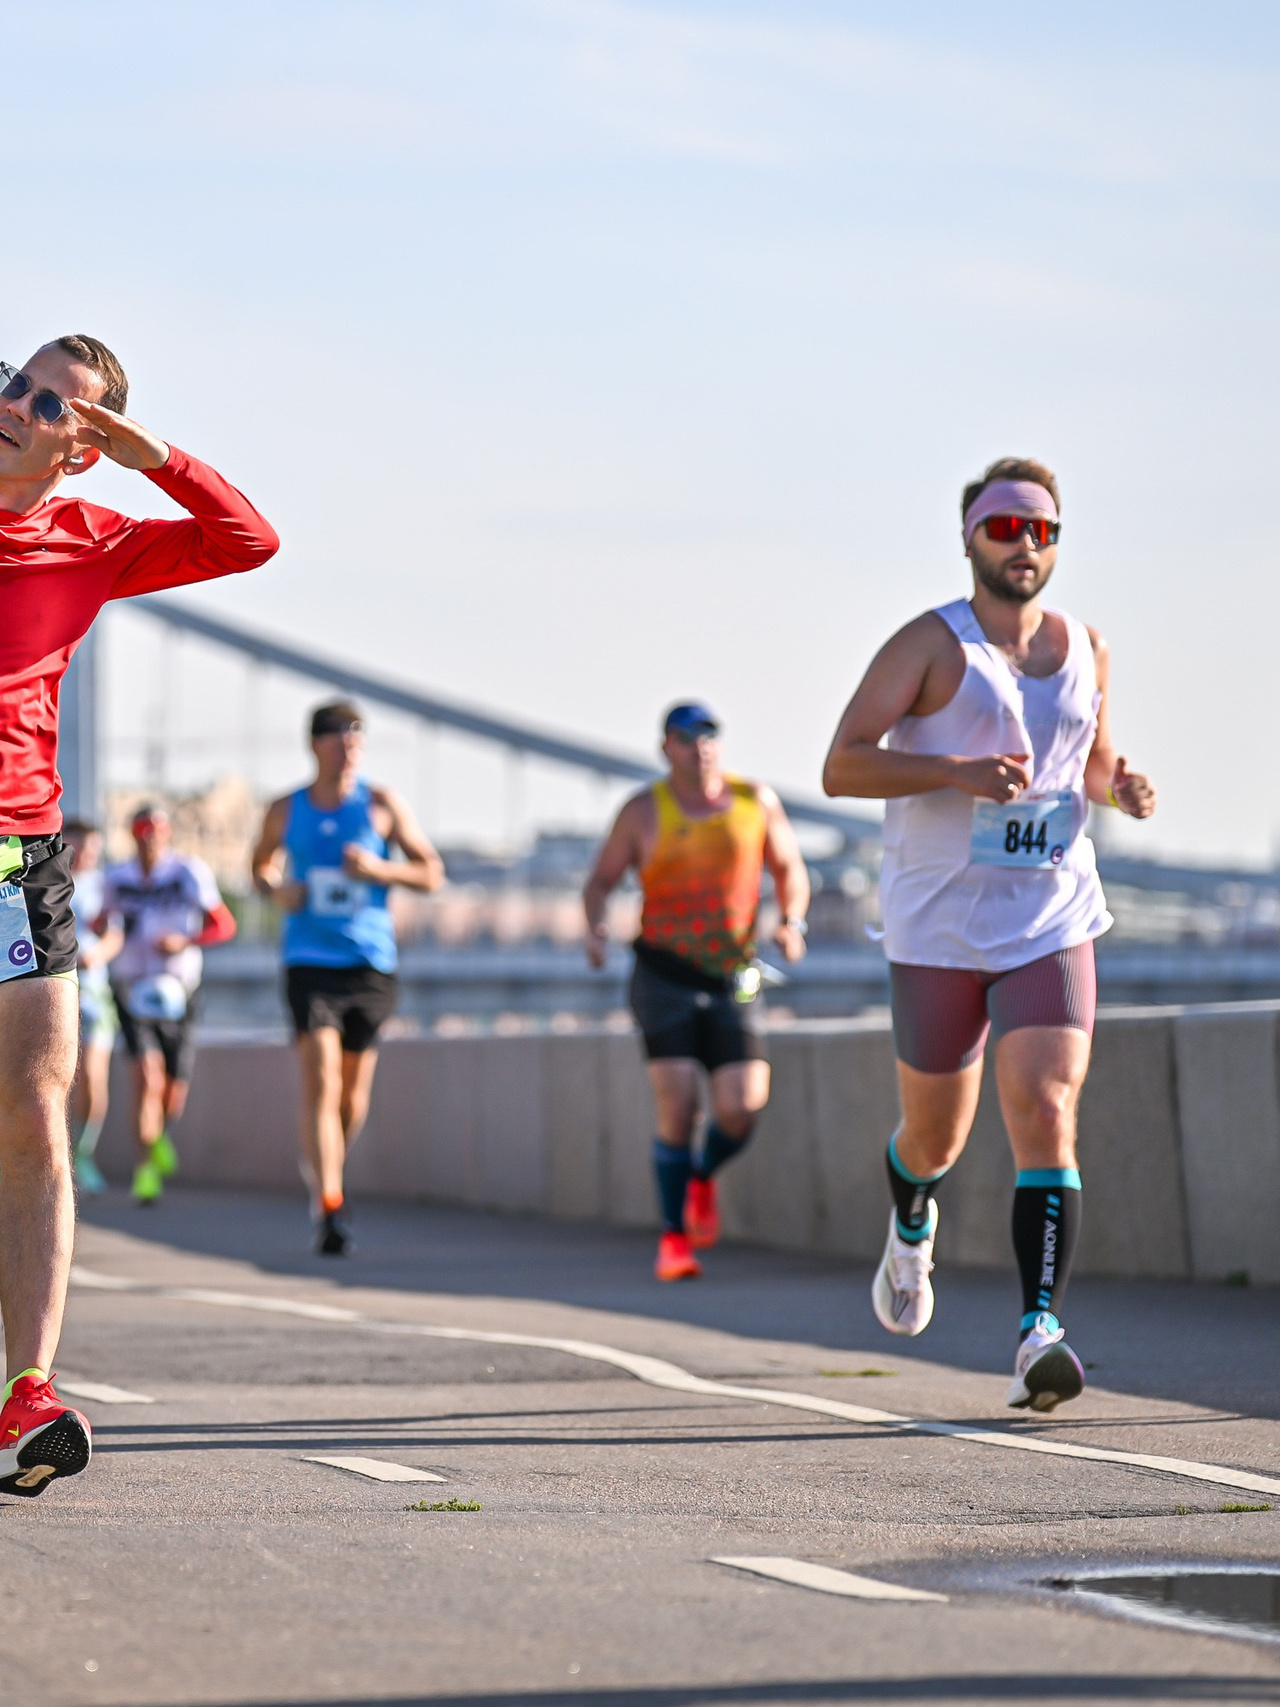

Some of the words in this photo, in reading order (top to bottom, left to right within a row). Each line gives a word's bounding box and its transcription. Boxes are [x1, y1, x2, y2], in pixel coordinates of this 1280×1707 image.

[1004, 819, 1048, 854] 844
[13, 944, 29, 961] C
[1040, 1220, 1057, 1286] AONIJE
